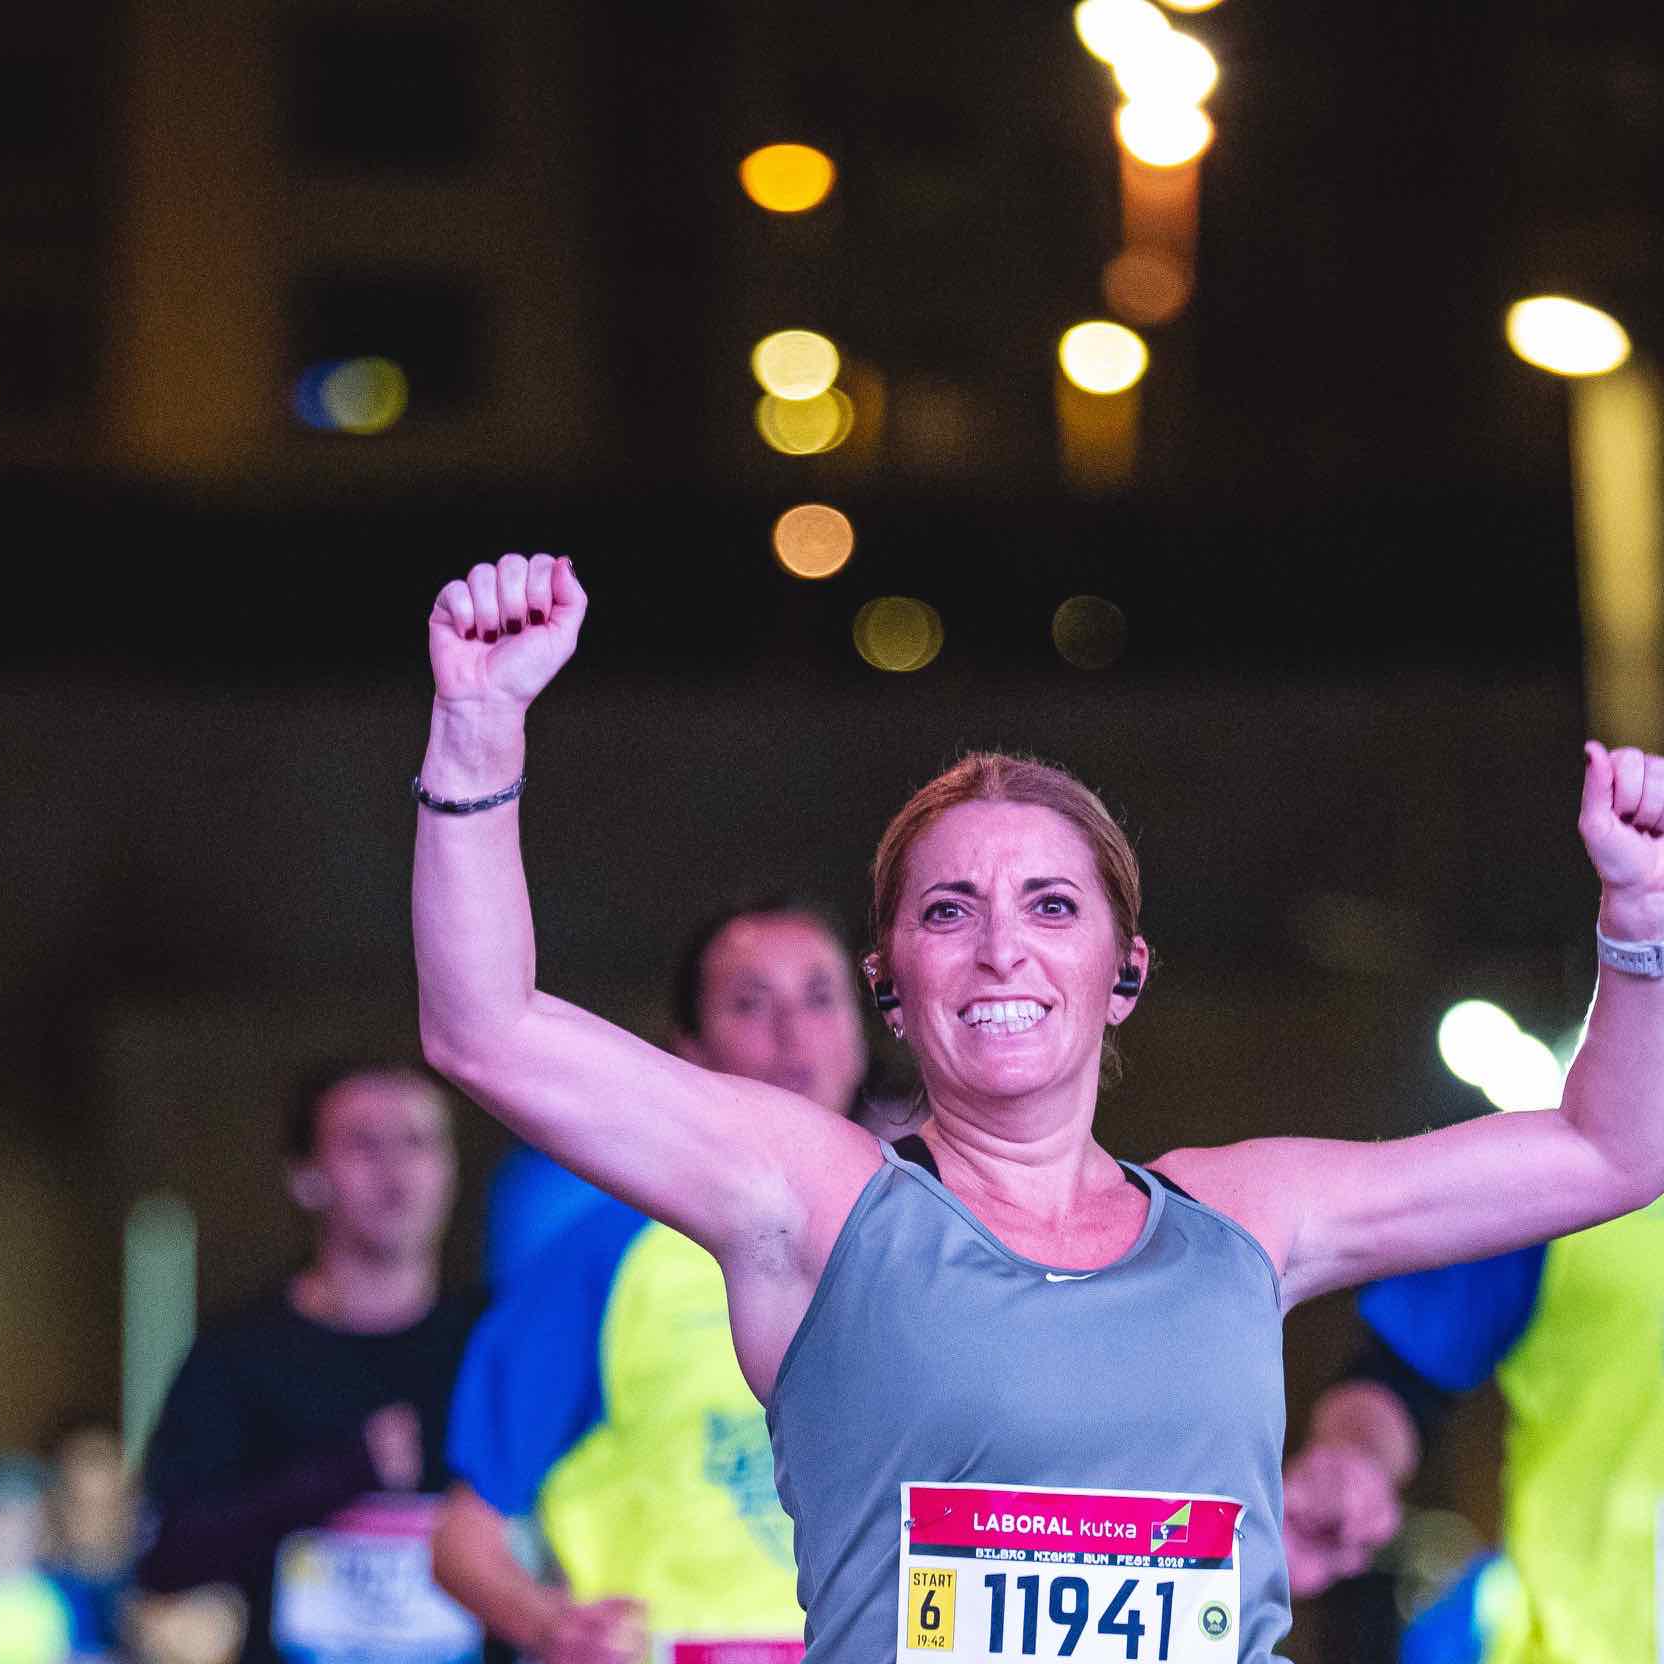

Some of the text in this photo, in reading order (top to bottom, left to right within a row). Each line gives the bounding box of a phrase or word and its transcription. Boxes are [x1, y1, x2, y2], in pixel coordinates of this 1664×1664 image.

[973, 1512, 1137, 1539] LABORAL kutxa
[975, 1548, 1026, 1561] BILBAO
[1034, 1550, 1075, 1564] NIGHT
[1083, 1553, 1108, 1565] RUN
[1117, 1555, 1151, 1567] FEST
[913, 1573, 953, 1588] START
[920, 1590, 941, 1630] 6
[984, 1573, 1175, 1661] 11941
[917, 1634, 945, 1648] 19:42
